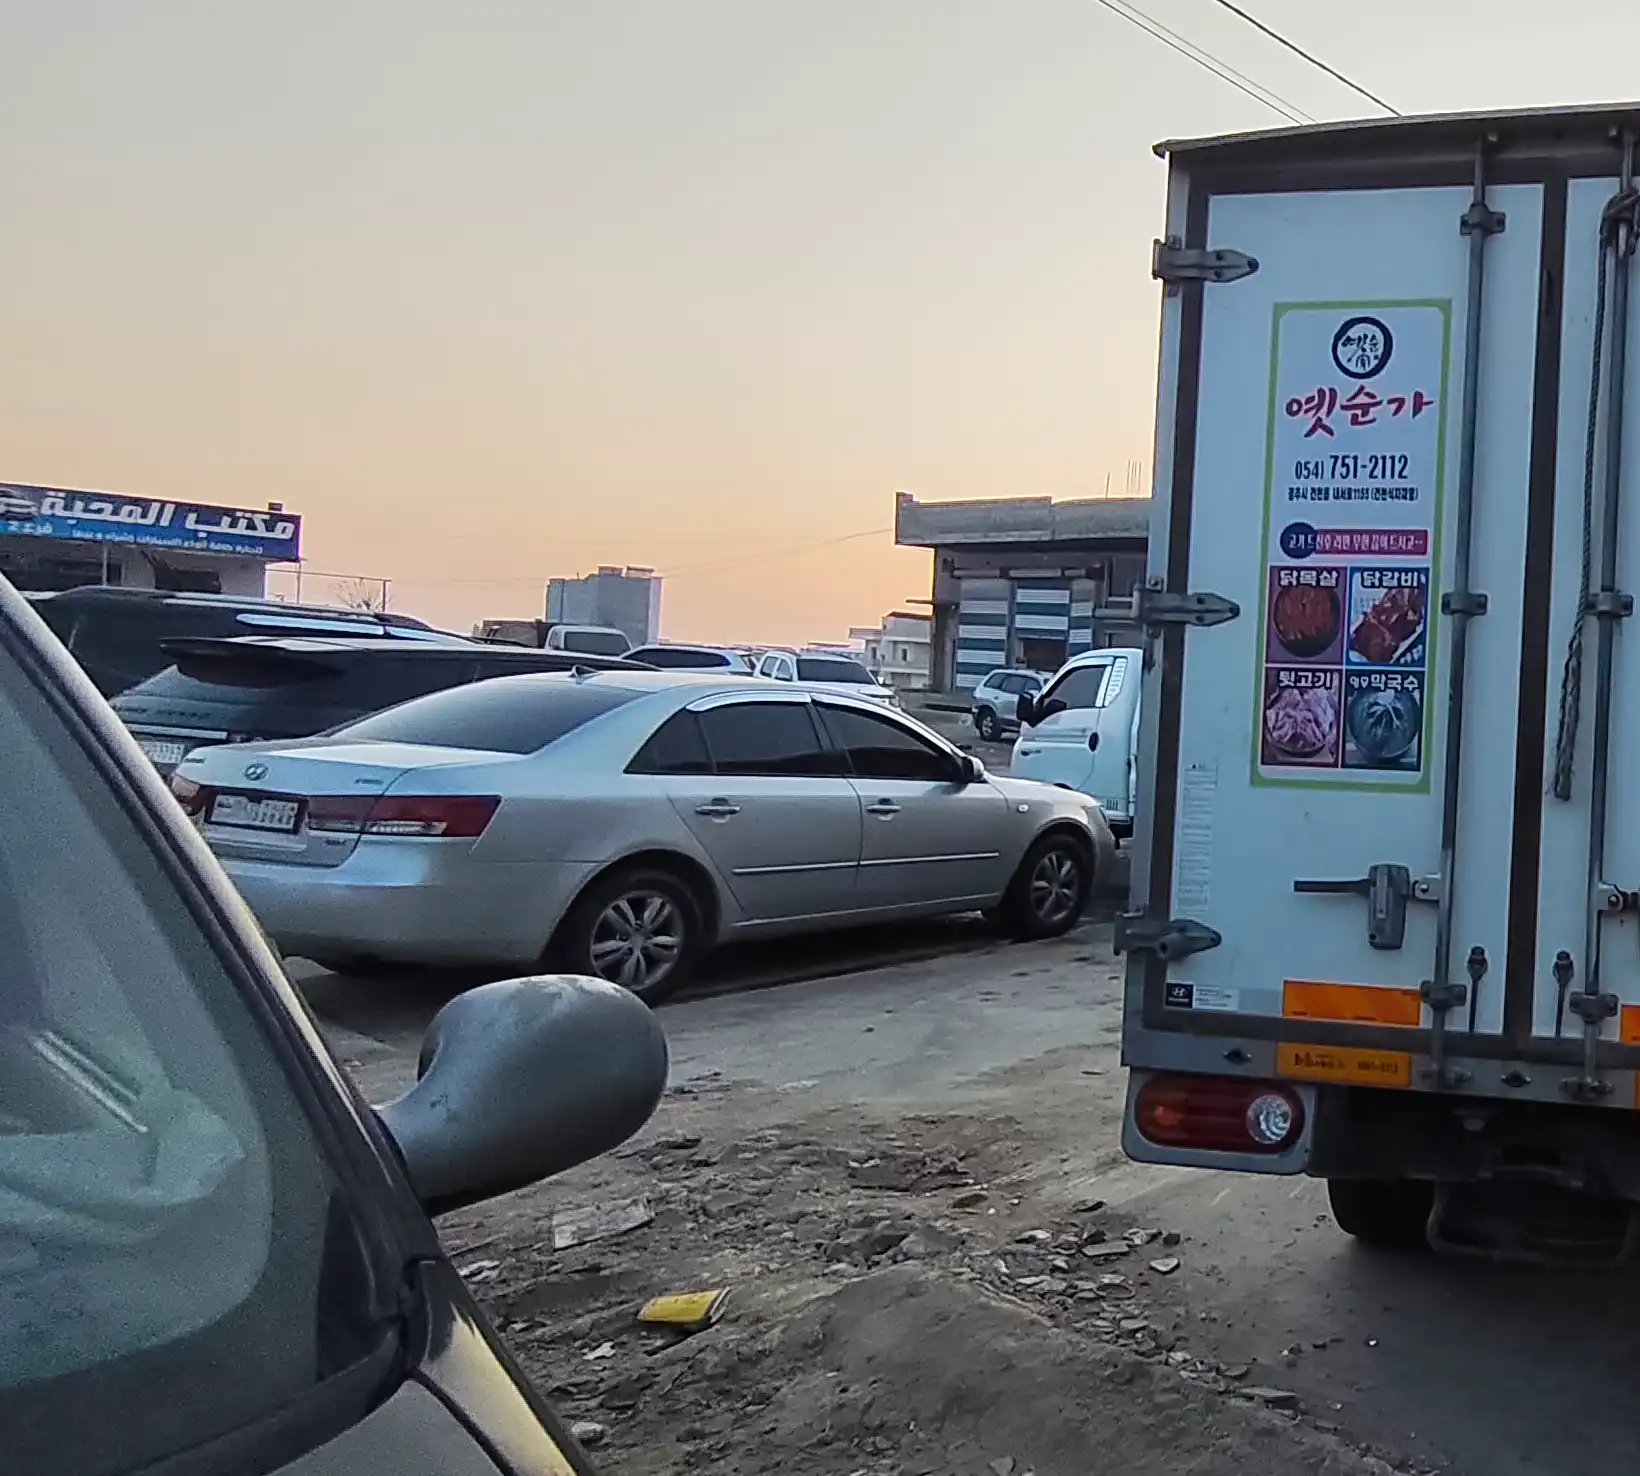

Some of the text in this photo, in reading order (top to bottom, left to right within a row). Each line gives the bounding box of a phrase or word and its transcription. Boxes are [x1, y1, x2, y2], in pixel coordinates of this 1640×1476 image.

[1285, 384, 1434, 438] 옛순가
[1295, 454, 1409, 480] 054) 751-2112
[41, 491, 296, 540] مكتب المحبة
[1280, 570, 1338, 587] 닭목살
[1362, 570, 1419, 587] 닭갈비
